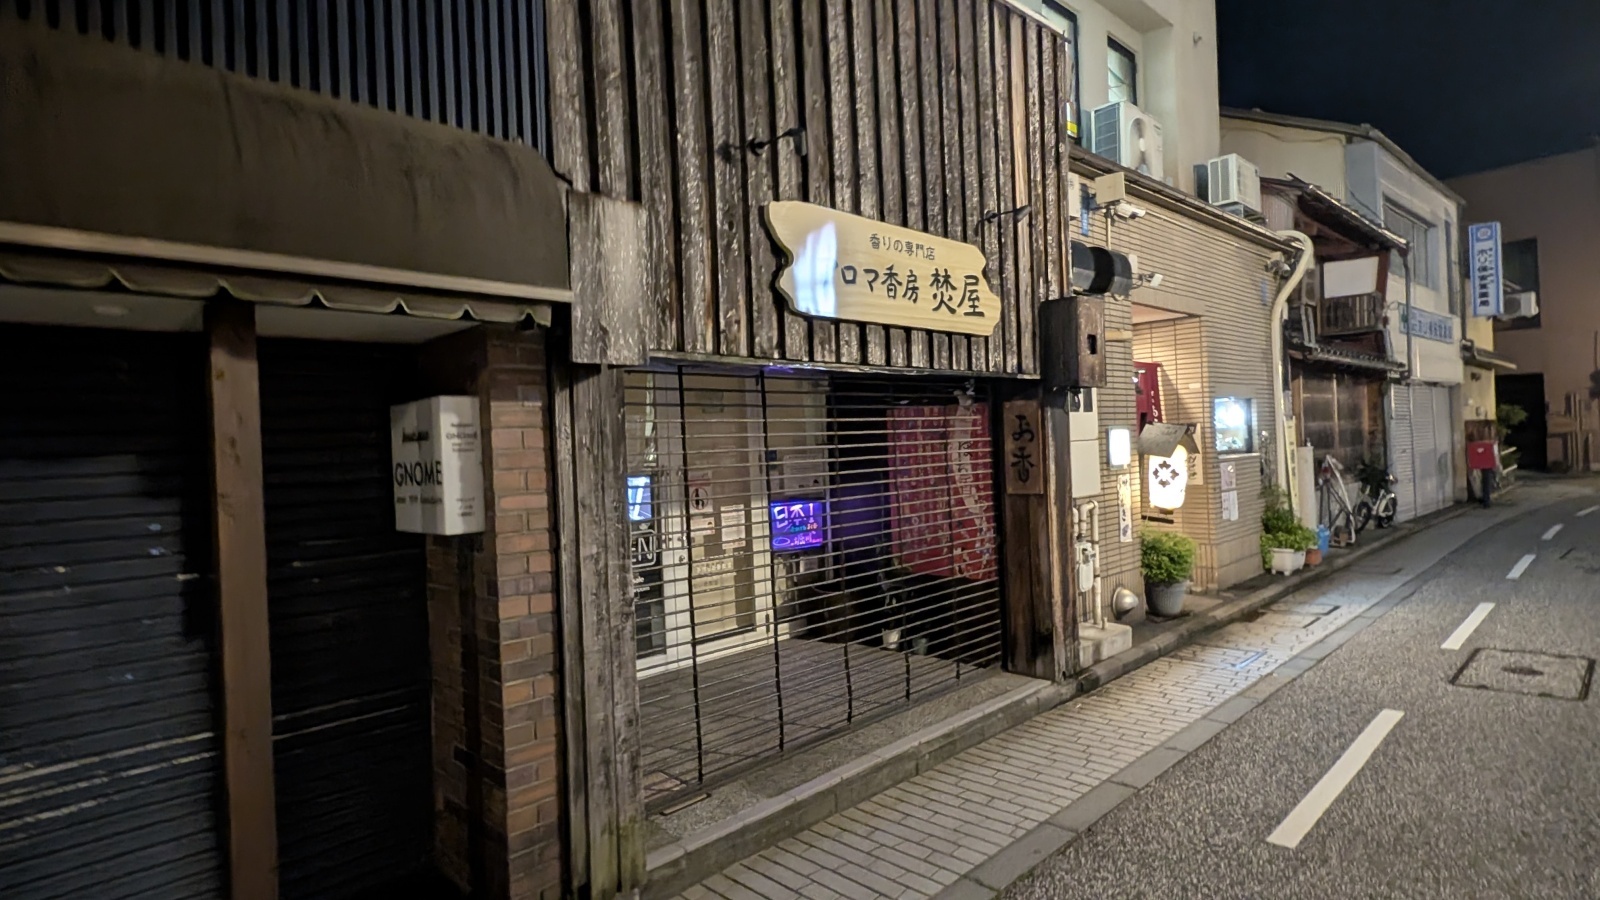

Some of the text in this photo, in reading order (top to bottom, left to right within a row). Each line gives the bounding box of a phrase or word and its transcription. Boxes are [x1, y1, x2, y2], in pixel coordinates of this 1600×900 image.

[869, 233, 936, 261] 香りの専門店
[836, 264, 986, 318] ロマ香房 焚屋
[1010, 414, 1036, 484] お香
[394, 460, 443, 487] GNOME
